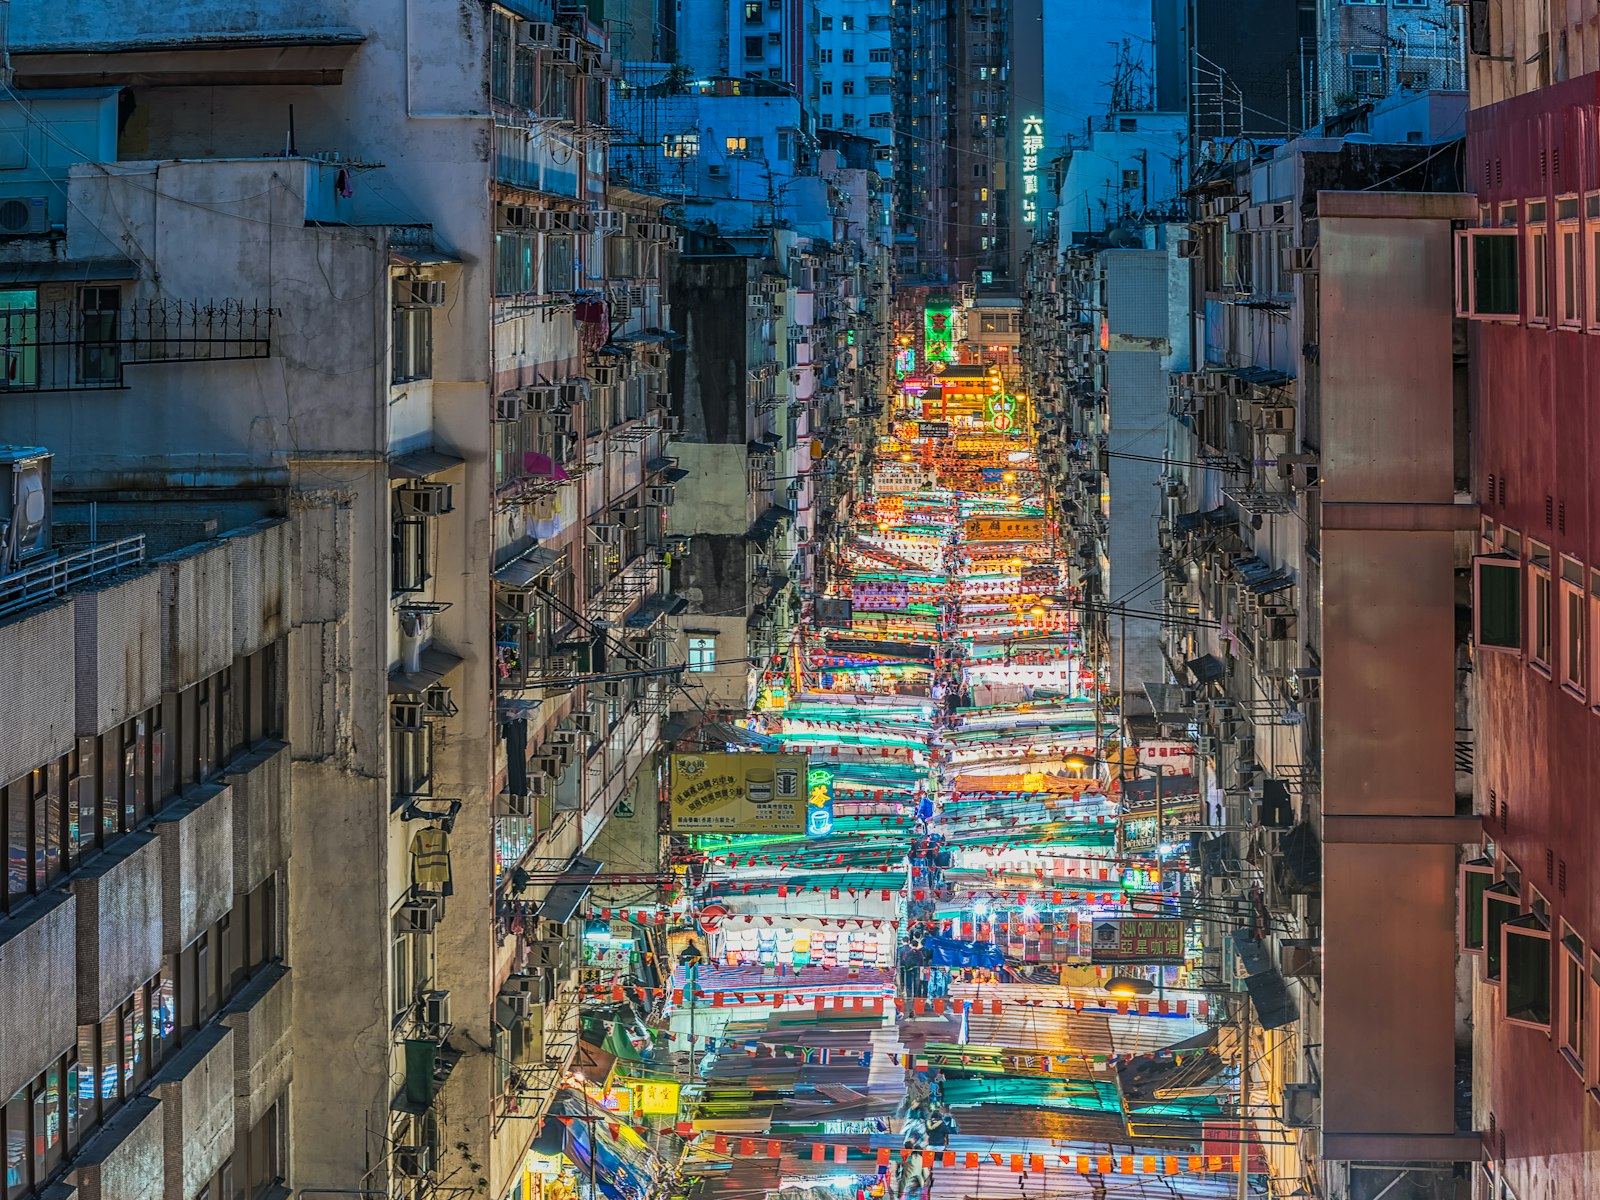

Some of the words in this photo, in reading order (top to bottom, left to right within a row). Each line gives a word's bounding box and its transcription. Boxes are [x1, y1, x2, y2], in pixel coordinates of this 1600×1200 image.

[1103, 697, 1120, 706] DV
[1126, 837, 1157, 847] WINNER
[1121, 921, 1136, 937] ASIAN
[1138, 921, 1154, 937] CURRY
[1157, 921, 1178, 937] KITCHEN
